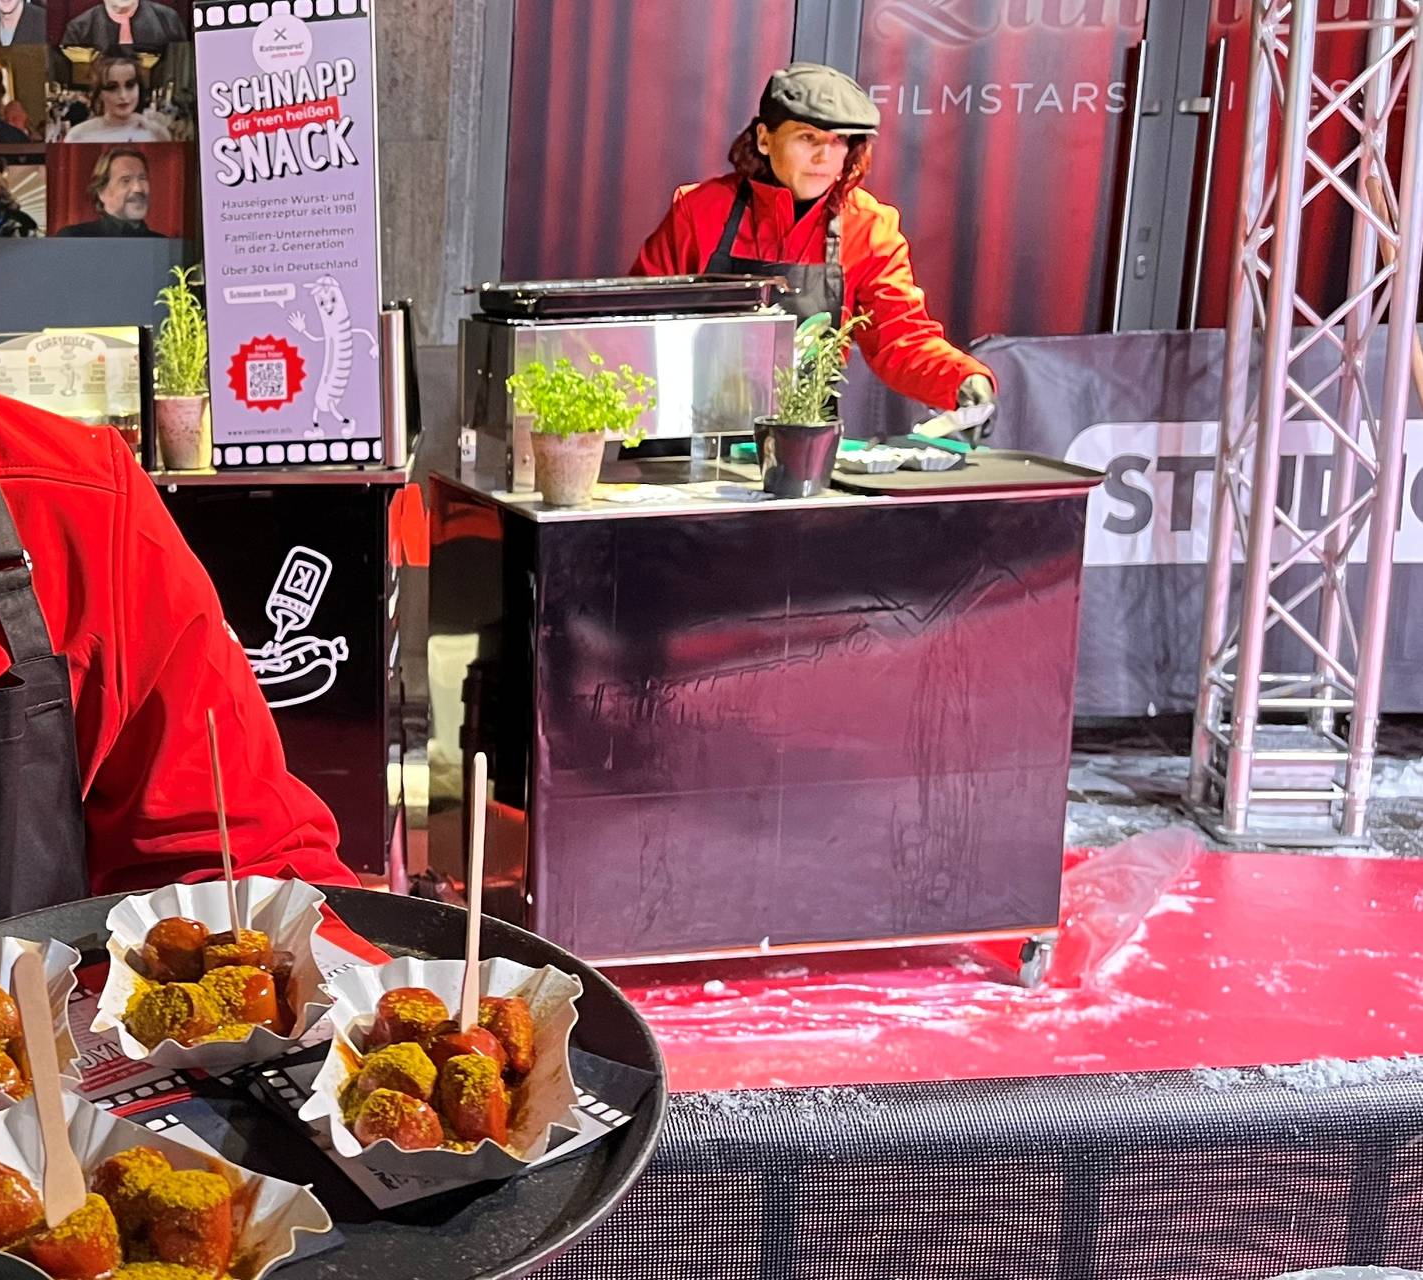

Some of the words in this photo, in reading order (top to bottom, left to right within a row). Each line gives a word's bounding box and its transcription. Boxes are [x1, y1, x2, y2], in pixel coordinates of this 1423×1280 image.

[209, 58, 356, 119] SCHNAPP
[869, 81, 1127, 116] FILMSTARS
[232, 119, 251, 132] dir
[285, 105, 334, 121] heißen
[212, 116, 359, 187] SNACK
[222, 197, 288, 210] Hauseigene
[290, 195, 329, 204] Wurst-
[332, 192, 355, 202] und
[220, 209, 308, 222] Saucenrezeptur
[311, 206, 332, 216] seit
[334, 204, 357, 214] 1981
[224, 227, 354, 242] Familien-Unternehmen
[234, 245, 245, 254] in
[248, 243, 267, 254] der
[270, 243, 279, 252] 2.
[282, 239, 345, 251] Generation
[221, 263, 248, 275] Über
[273, 264, 284, 273] in
[287, 258, 359, 272] Deutschland
